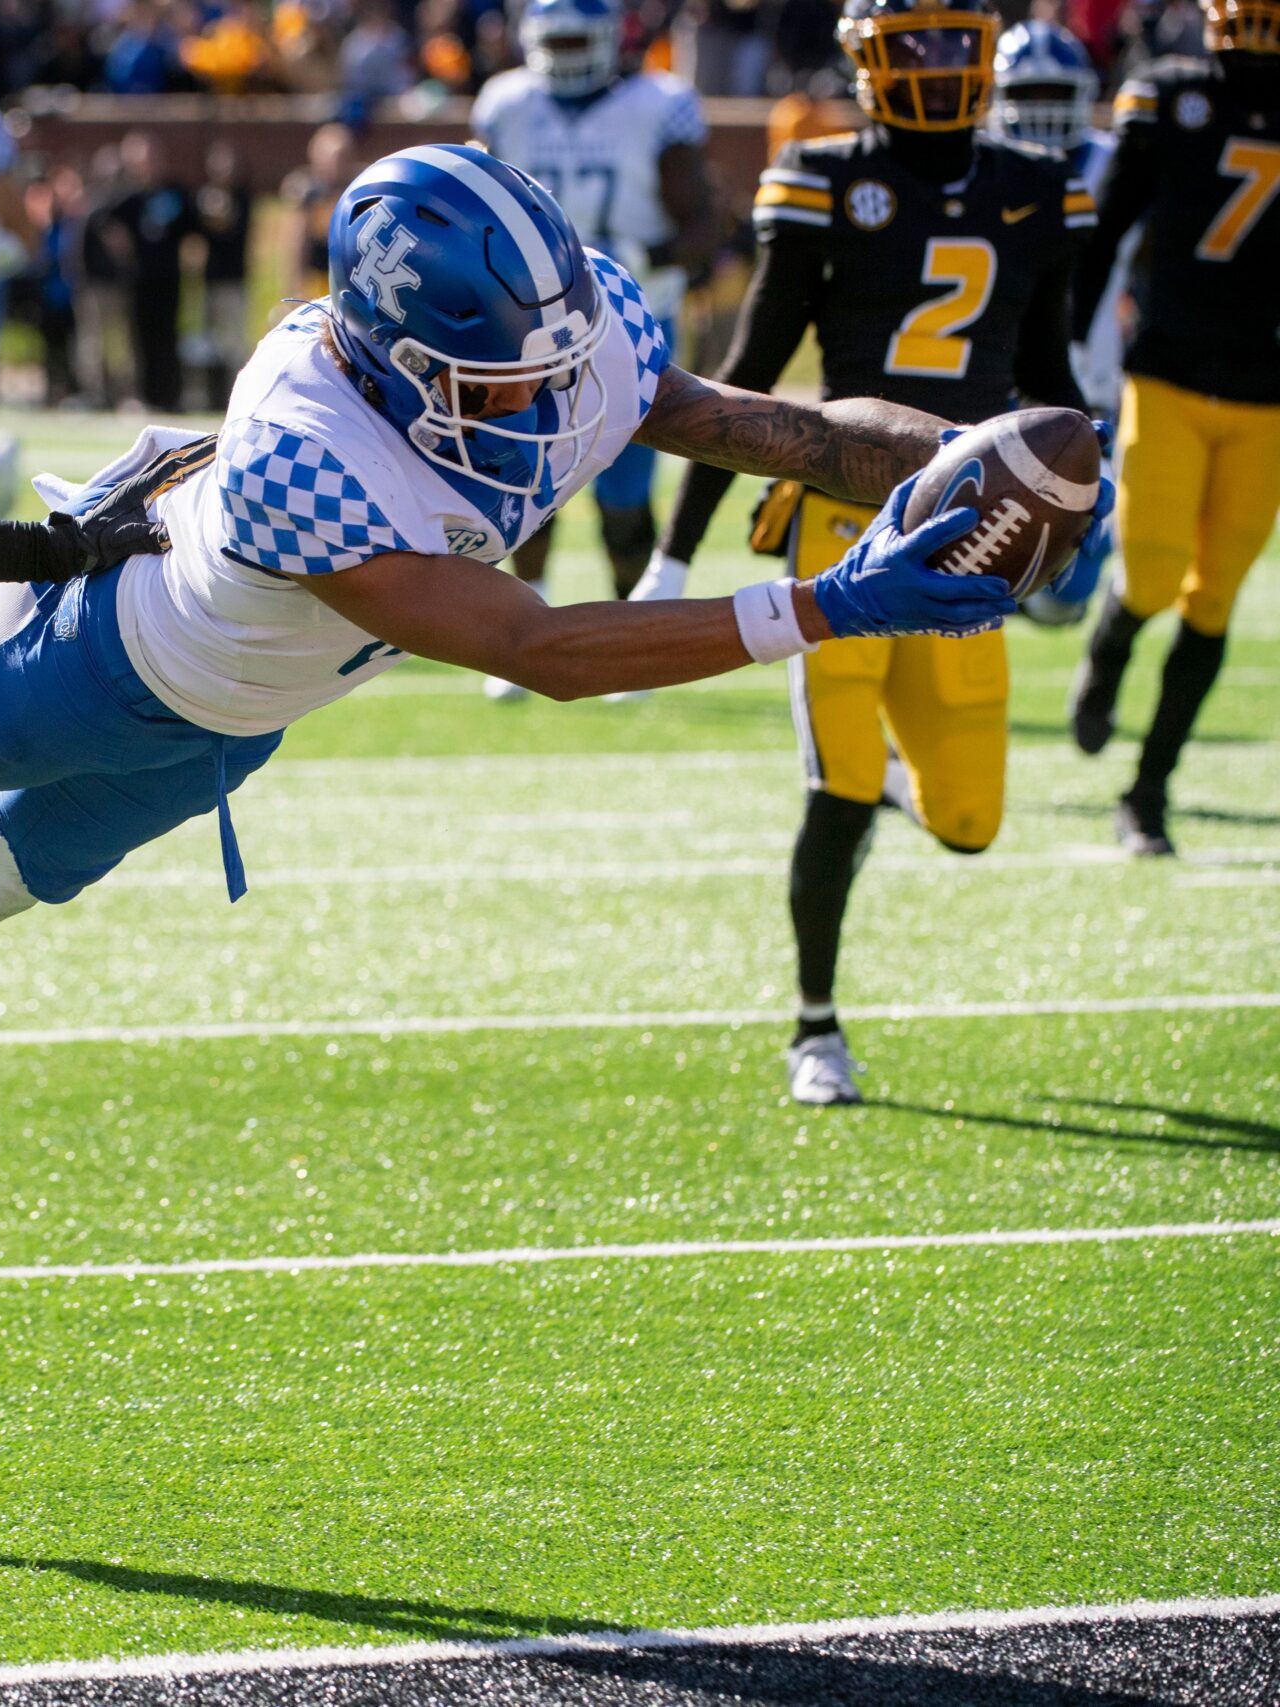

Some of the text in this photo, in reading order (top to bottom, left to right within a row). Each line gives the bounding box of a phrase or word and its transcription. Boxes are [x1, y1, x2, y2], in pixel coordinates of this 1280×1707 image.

[1194, 136, 1280, 262] 7
[350, 201, 421, 324] UK
[883, 235, 999, 379] 2
[444, 528, 488, 555] EC
